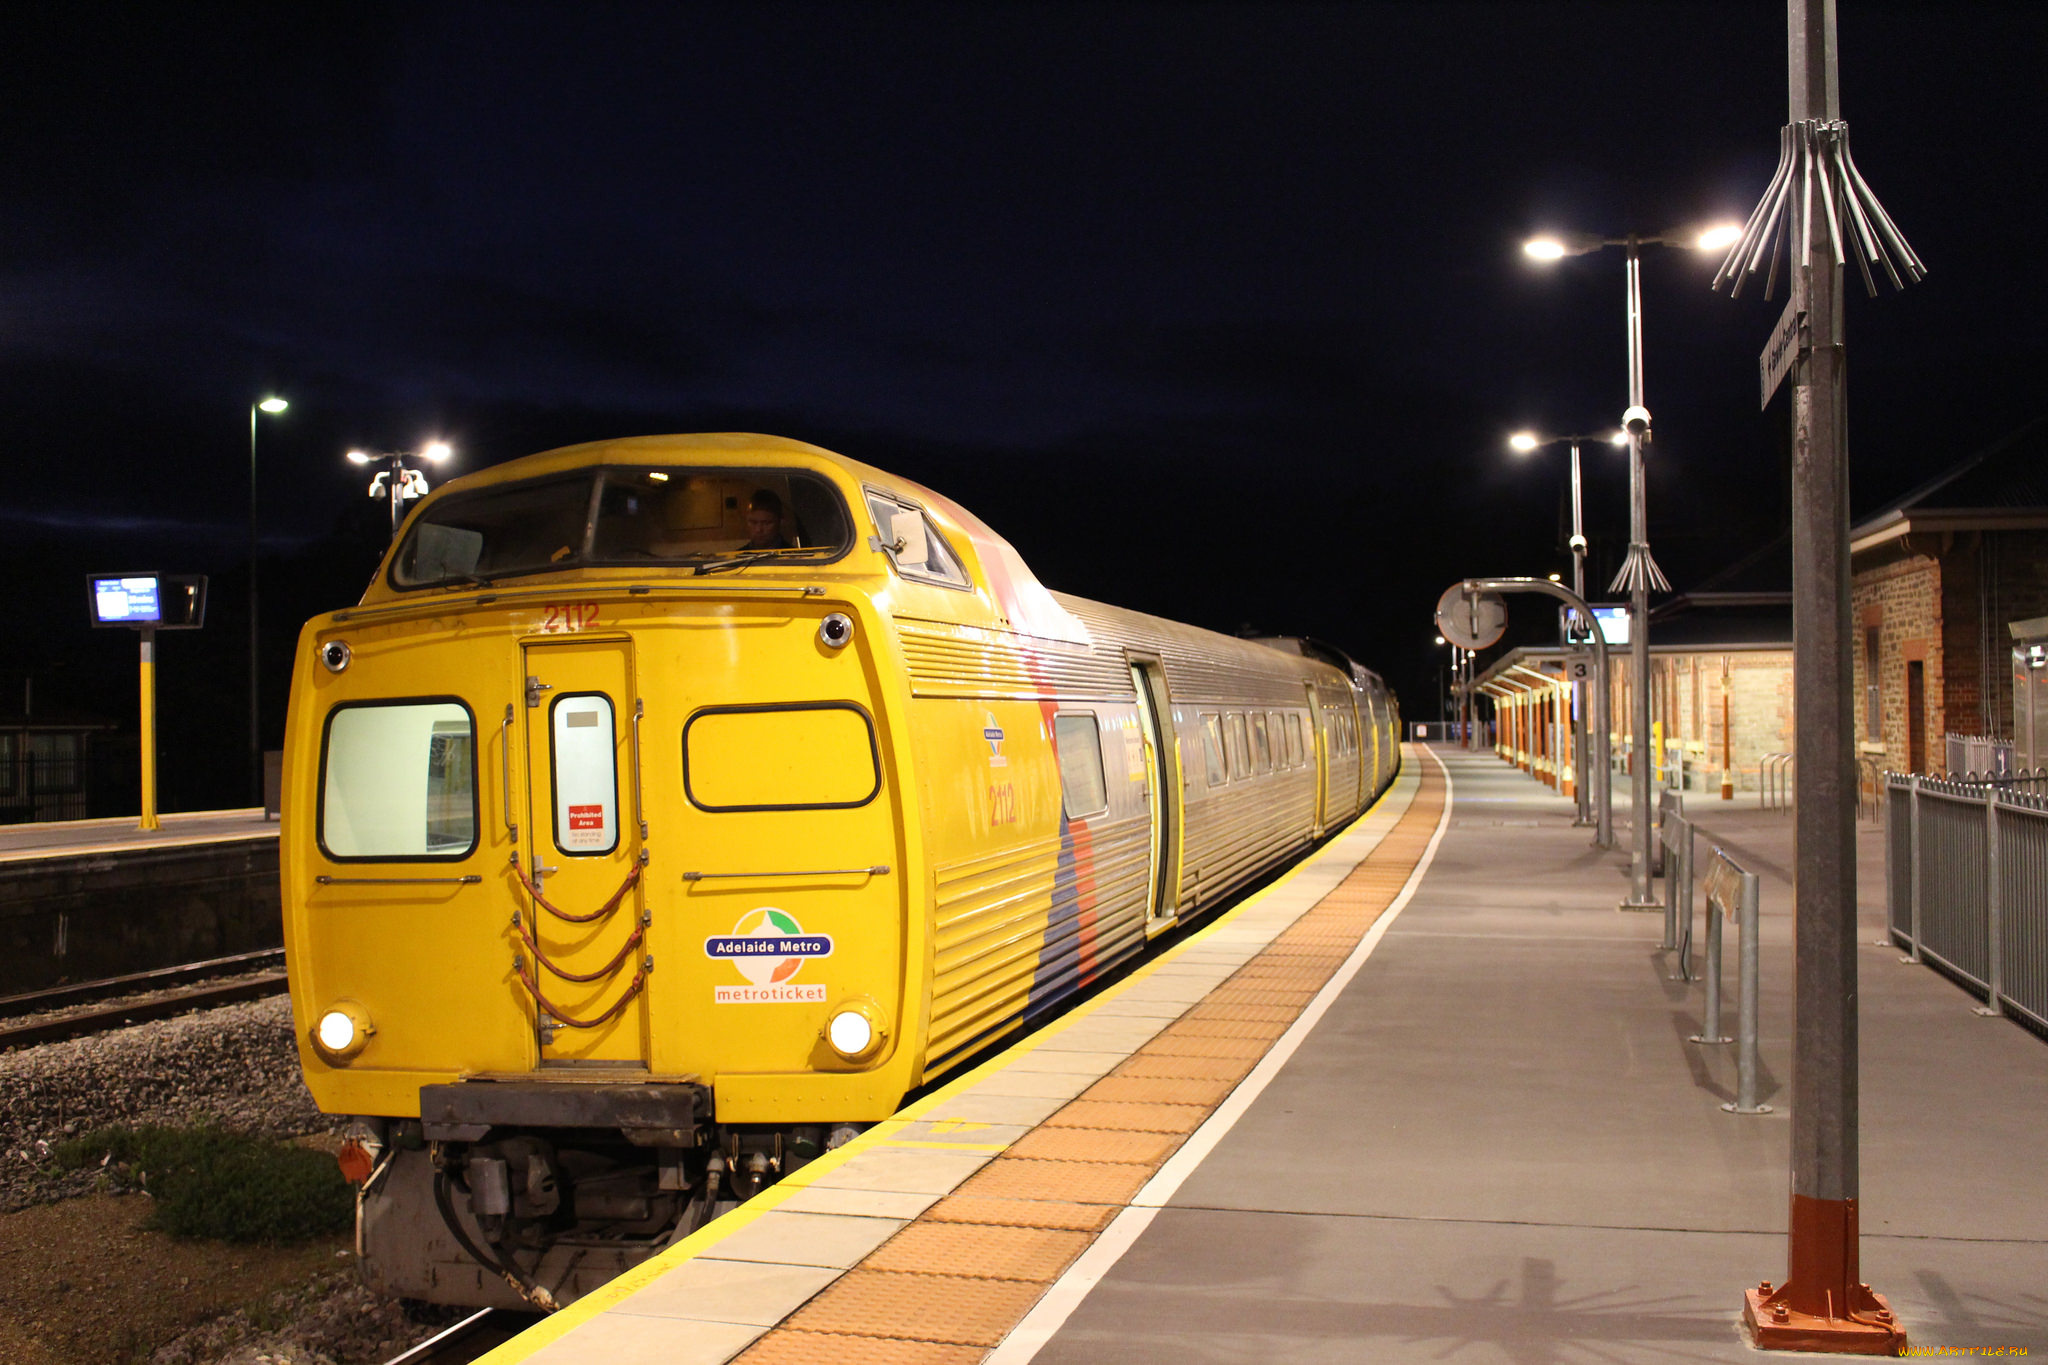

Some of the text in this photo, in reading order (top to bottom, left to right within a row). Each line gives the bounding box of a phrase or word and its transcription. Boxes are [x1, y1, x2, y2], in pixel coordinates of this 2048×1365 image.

[544, 602, 600, 630] 2112
[1574, 663, 1586, 677] 3
[989, 783, 1016, 827] 2112
[716, 941, 821, 953] Adelaide Metro
[717, 986, 824, 1000] metroticket
